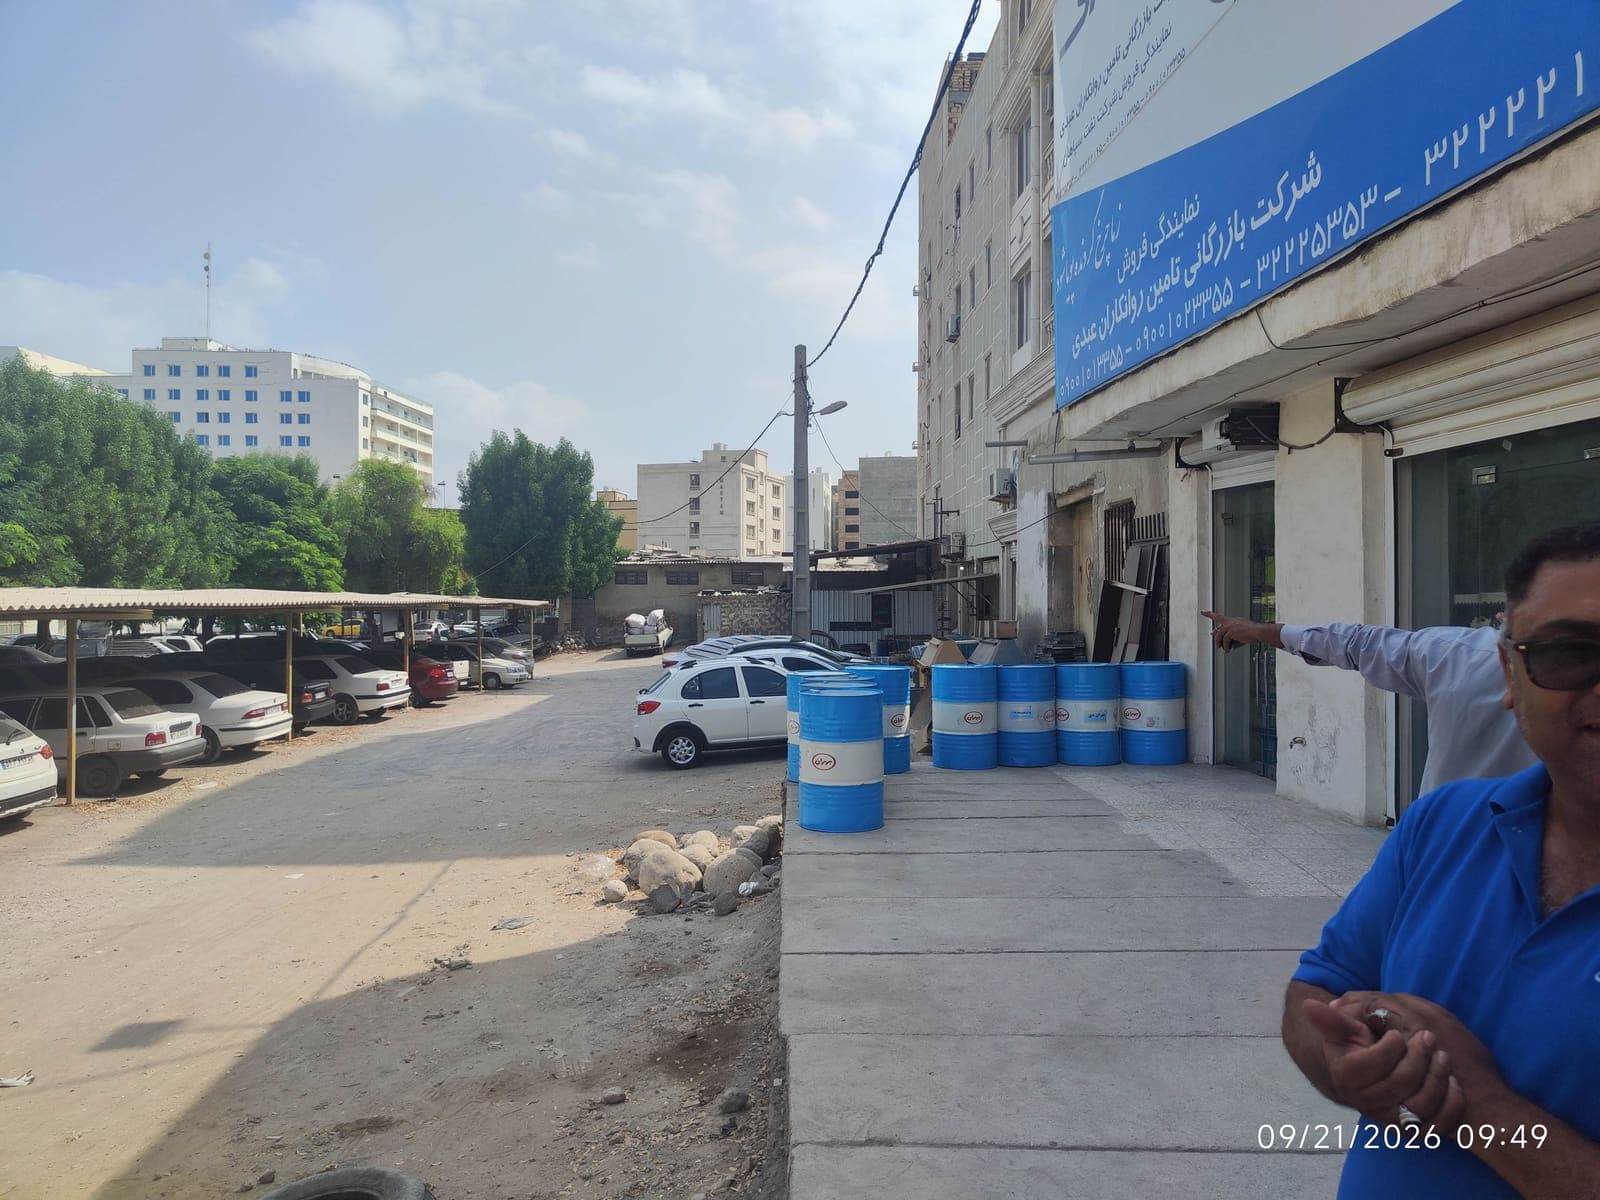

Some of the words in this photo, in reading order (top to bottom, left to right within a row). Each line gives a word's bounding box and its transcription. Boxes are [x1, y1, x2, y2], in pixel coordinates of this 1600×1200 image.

[1140, 21, 1172, 75] نمایندگی
[1097, 88, 1118, 122] شرکت
[1118, 59, 1139, 101] فروش
[1251, 150, 1322, 231] شرکت
[1150, 193, 1200, 259] نمایندگی
[1184, 209, 1246, 288] بازرگانی
[1257, 184, 1378, 290] ۳۲۲۲۵۳۵۳
[1117, 231, 1148, 285] فروش
[1147, 256, 1181, 313] تامین
[1072, 323, 1097, 359] عبدی
[1099, 288, 1144, 341] روانکاران
[1136, 277, 1234, 351] ۰۹۰۰۱۰۲۳۳۵۵
